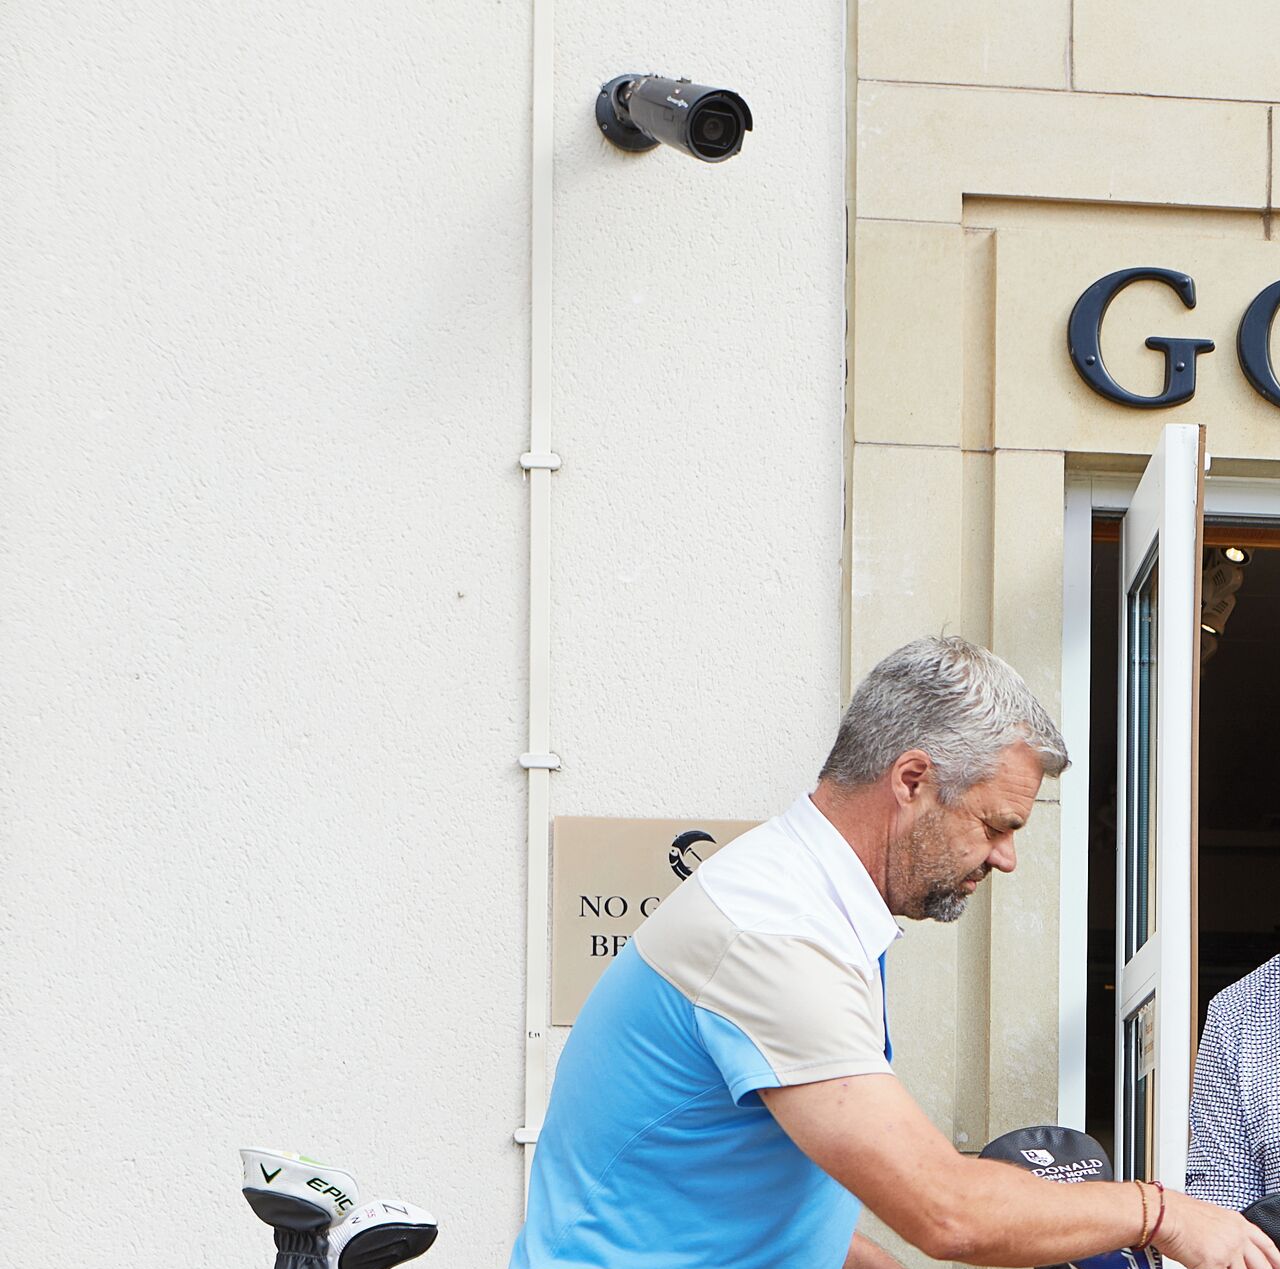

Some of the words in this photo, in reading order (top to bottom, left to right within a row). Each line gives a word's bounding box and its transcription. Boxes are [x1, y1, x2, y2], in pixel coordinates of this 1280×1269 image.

[578, 895, 628, 919] NO
[1032, 1158, 1103, 1177] DONALD
[306, 1177, 354, 1211] EPIC
